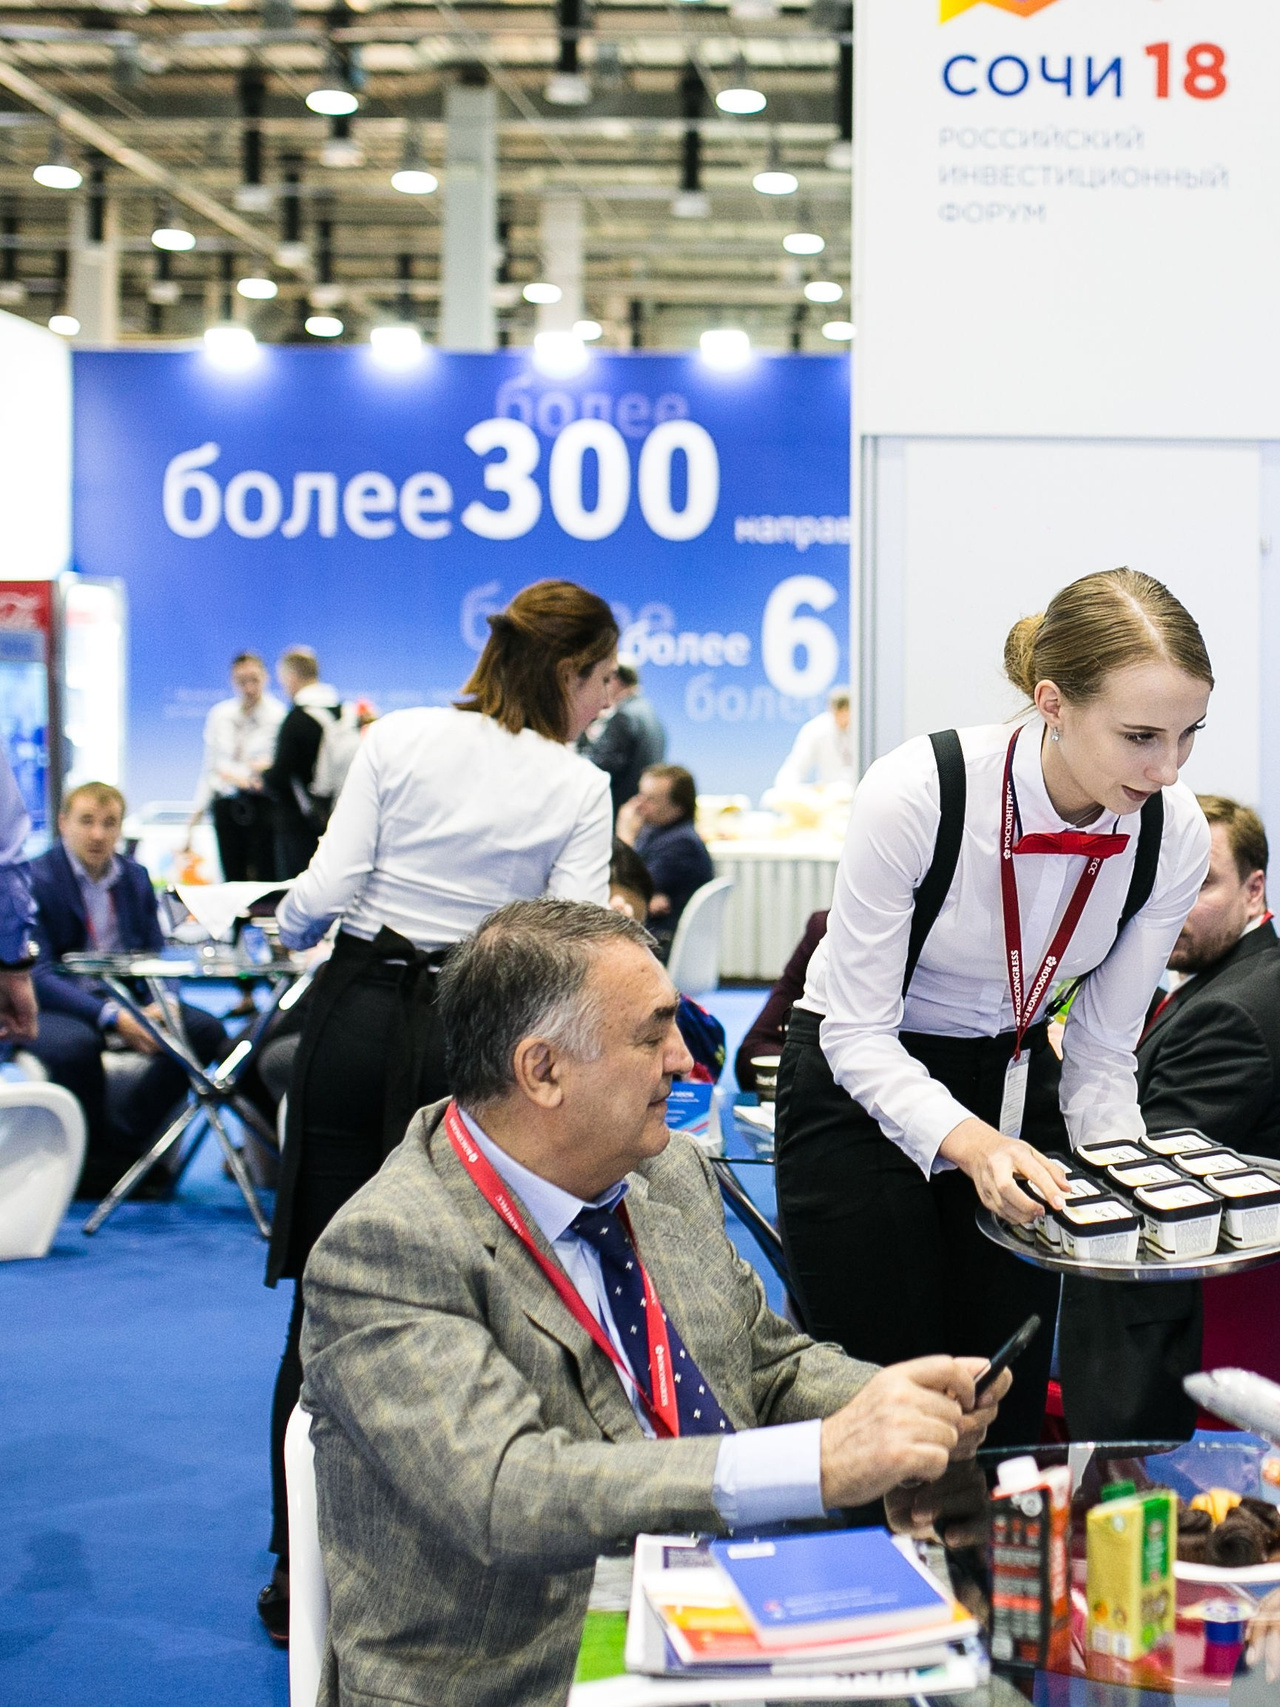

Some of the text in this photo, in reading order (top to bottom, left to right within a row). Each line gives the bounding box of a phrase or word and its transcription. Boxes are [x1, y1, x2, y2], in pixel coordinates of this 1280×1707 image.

[942, 41, 1228, 101] СОЧИ 18
[938, 123, 1146, 151] РОССИЙСКИЙ
[937, 161, 1231, 191] ИНВЕСТИЦИОННЫЙ
[937, 201, 1048, 225] ФОРУМ
[163, 442, 454, 540] более
[461, 418, 721, 542] 300
[620, 618, 750, 669] более
[761, 574, 840, 698] 6
[1010, 949, 1022, 1016] ROSCONGRESS
